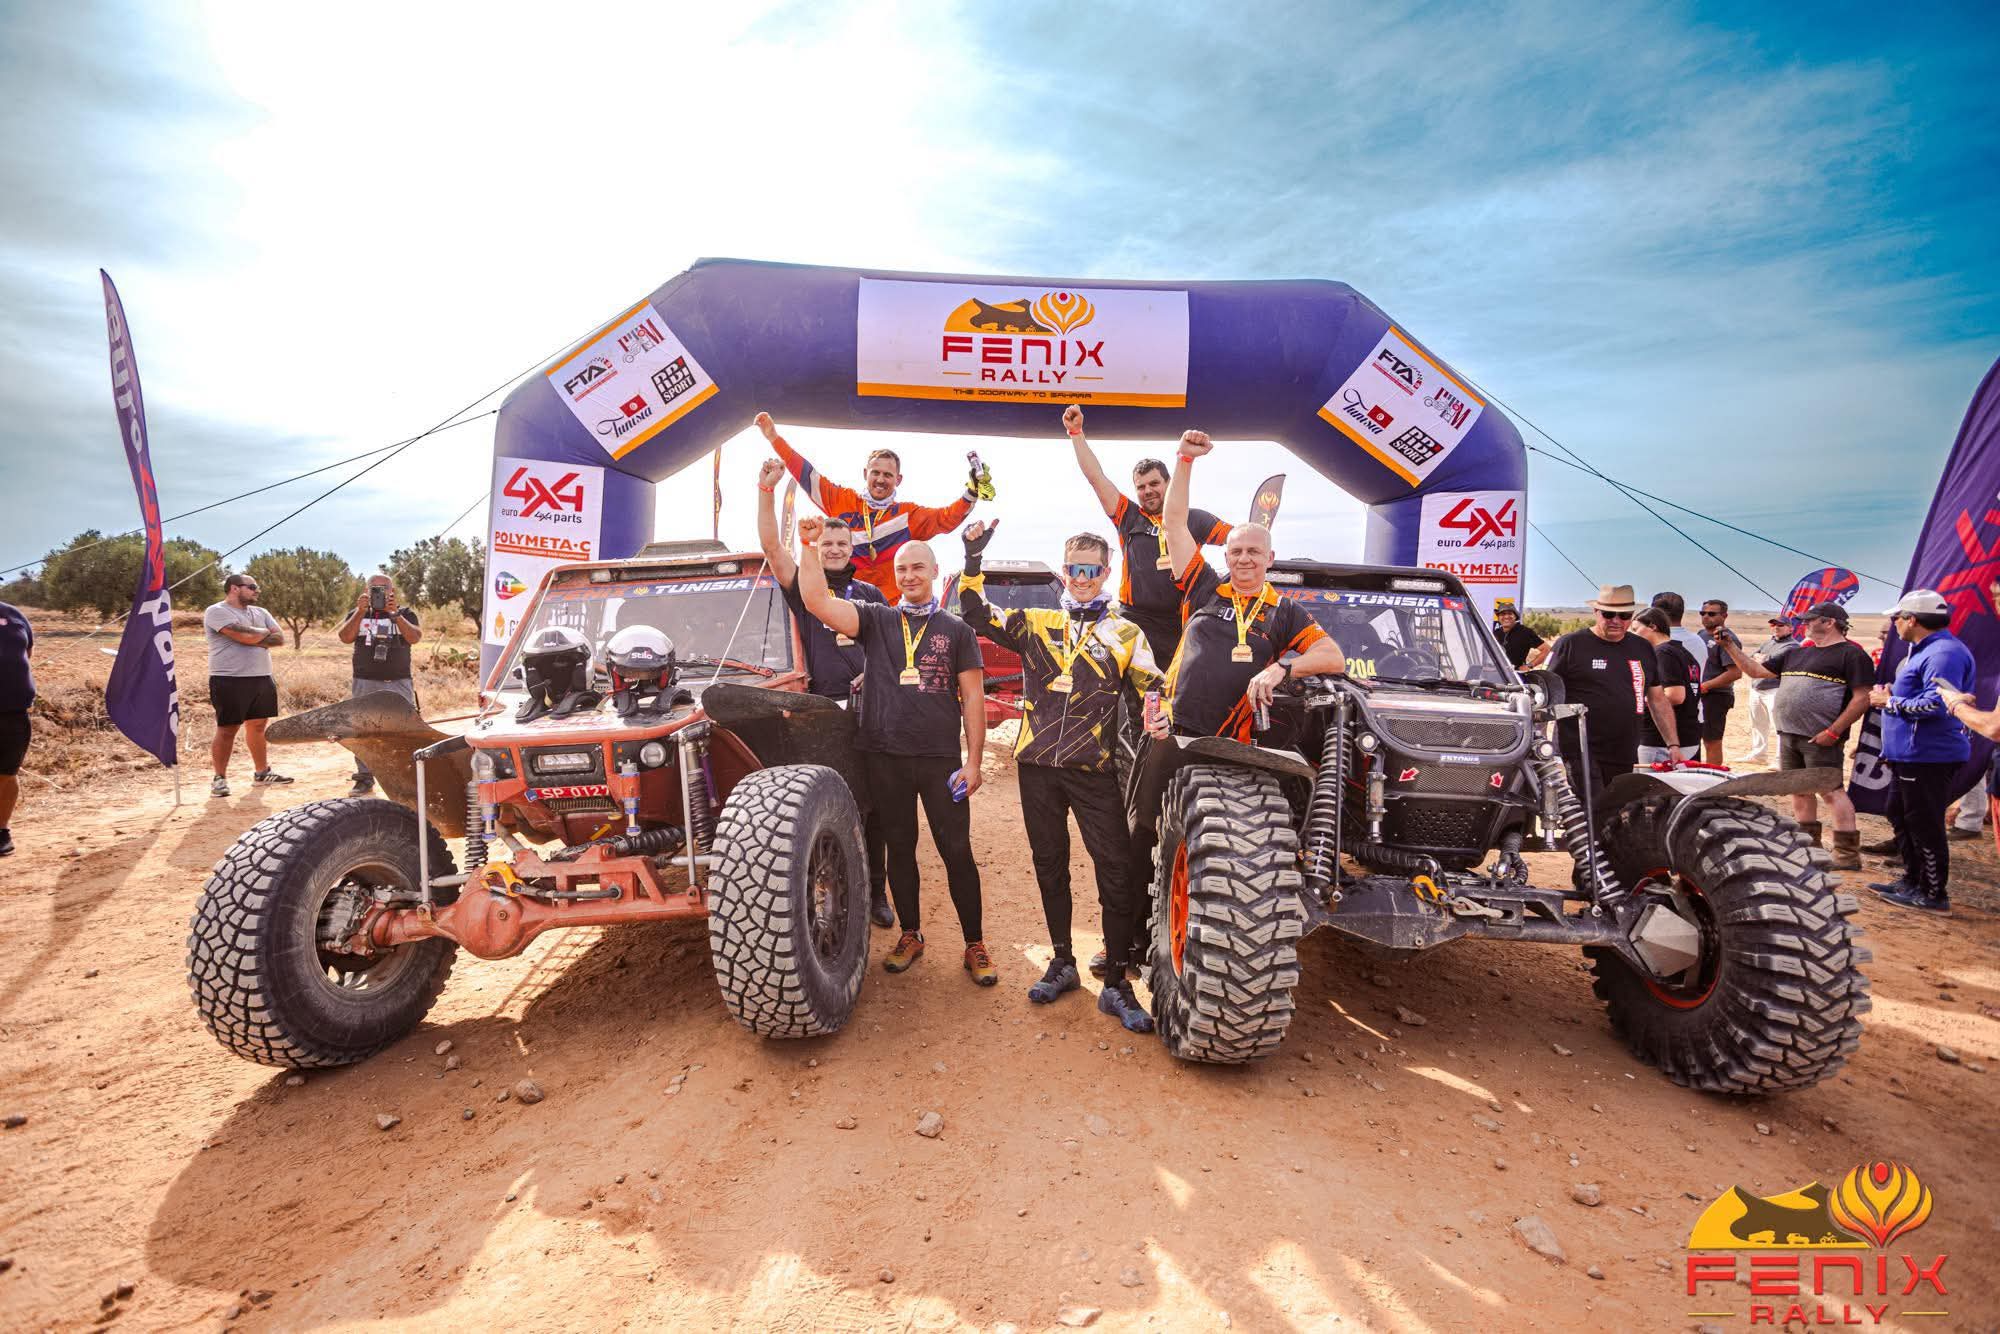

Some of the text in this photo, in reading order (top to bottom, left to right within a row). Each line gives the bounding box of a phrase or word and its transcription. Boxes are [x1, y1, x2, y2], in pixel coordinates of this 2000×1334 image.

[943, 335, 1104, 367] FENIX
[981, 368, 1068, 384] RALLY
[1377, 348, 1414, 385] FTA
[563, 364, 607, 395] FTA
[662, 375, 693, 402] SPORT
[978, 389, 1028, 397] DOORWAY
[596, 406, 653, 438] Tunisia
[1343, 388, 1385, 435] Tunisia
[1392, 439, 1425, 464] SPORT
[501, 508, 582, 524] euro 4x4 parts
[1437, 539, 1516, 550] euro 4x4 parts
[655, 580, 750, 595] TUNISIA
[1344, 593, 1440, 608] TUNISIA
[1345, 658, 1377, 679] 204
[1630, 660, 1644, 713] ORGANISATION
[541, 787, 564, 799] SP
